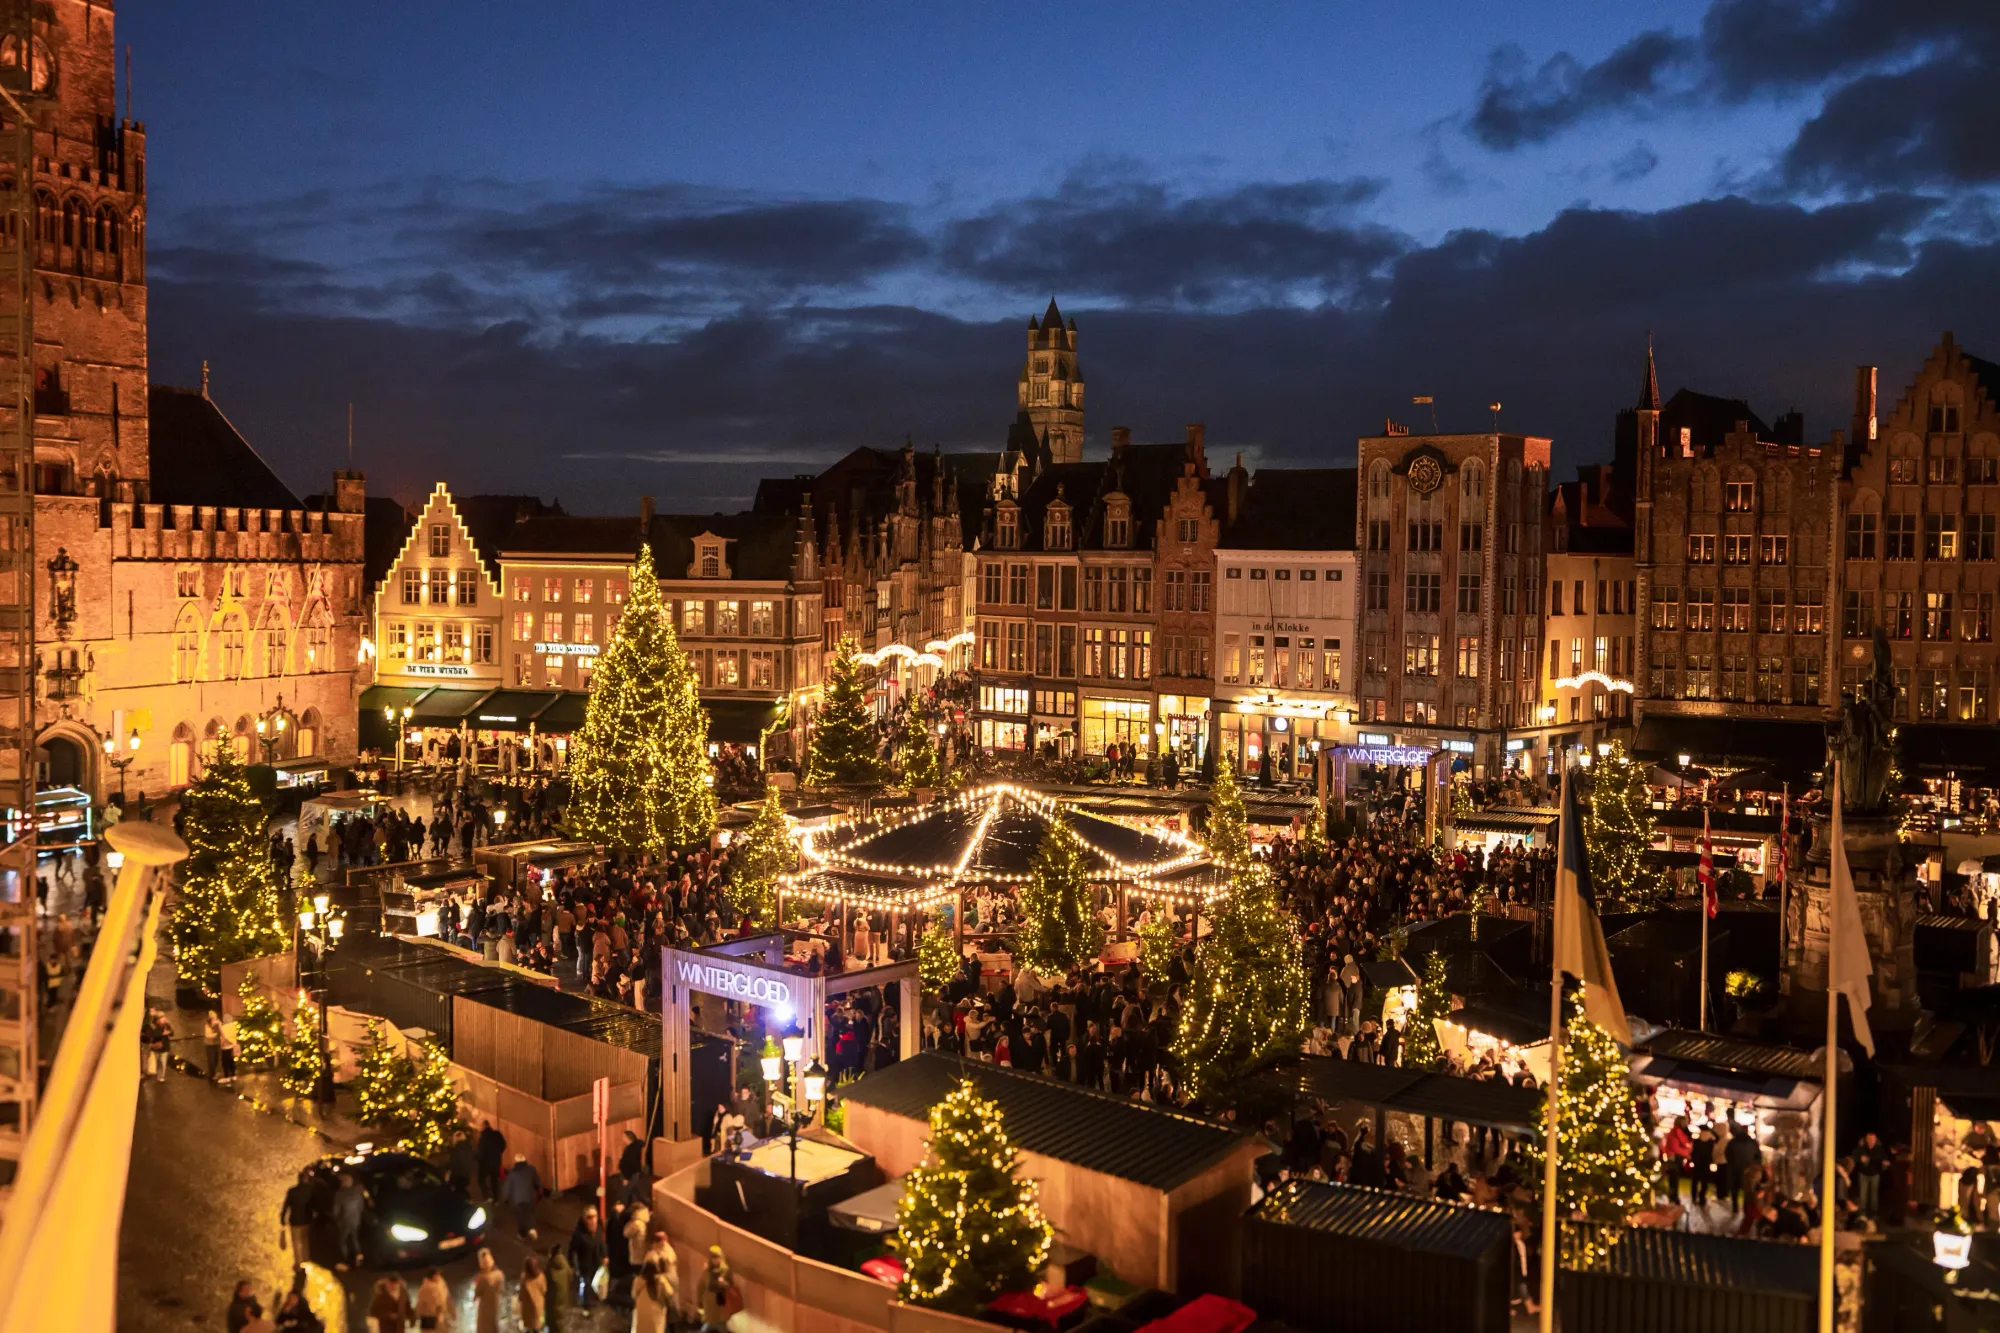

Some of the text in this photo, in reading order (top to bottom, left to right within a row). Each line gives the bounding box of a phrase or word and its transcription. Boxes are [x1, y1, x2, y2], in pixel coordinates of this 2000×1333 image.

[1252, 622, 1310, 632] in de Klokke
[407, 665, 468, 675] DE VIER WINDEN
[1402, 727, 1428, 737] WASBAR
[677, 960, 790, 1003] WINTERGLOED
